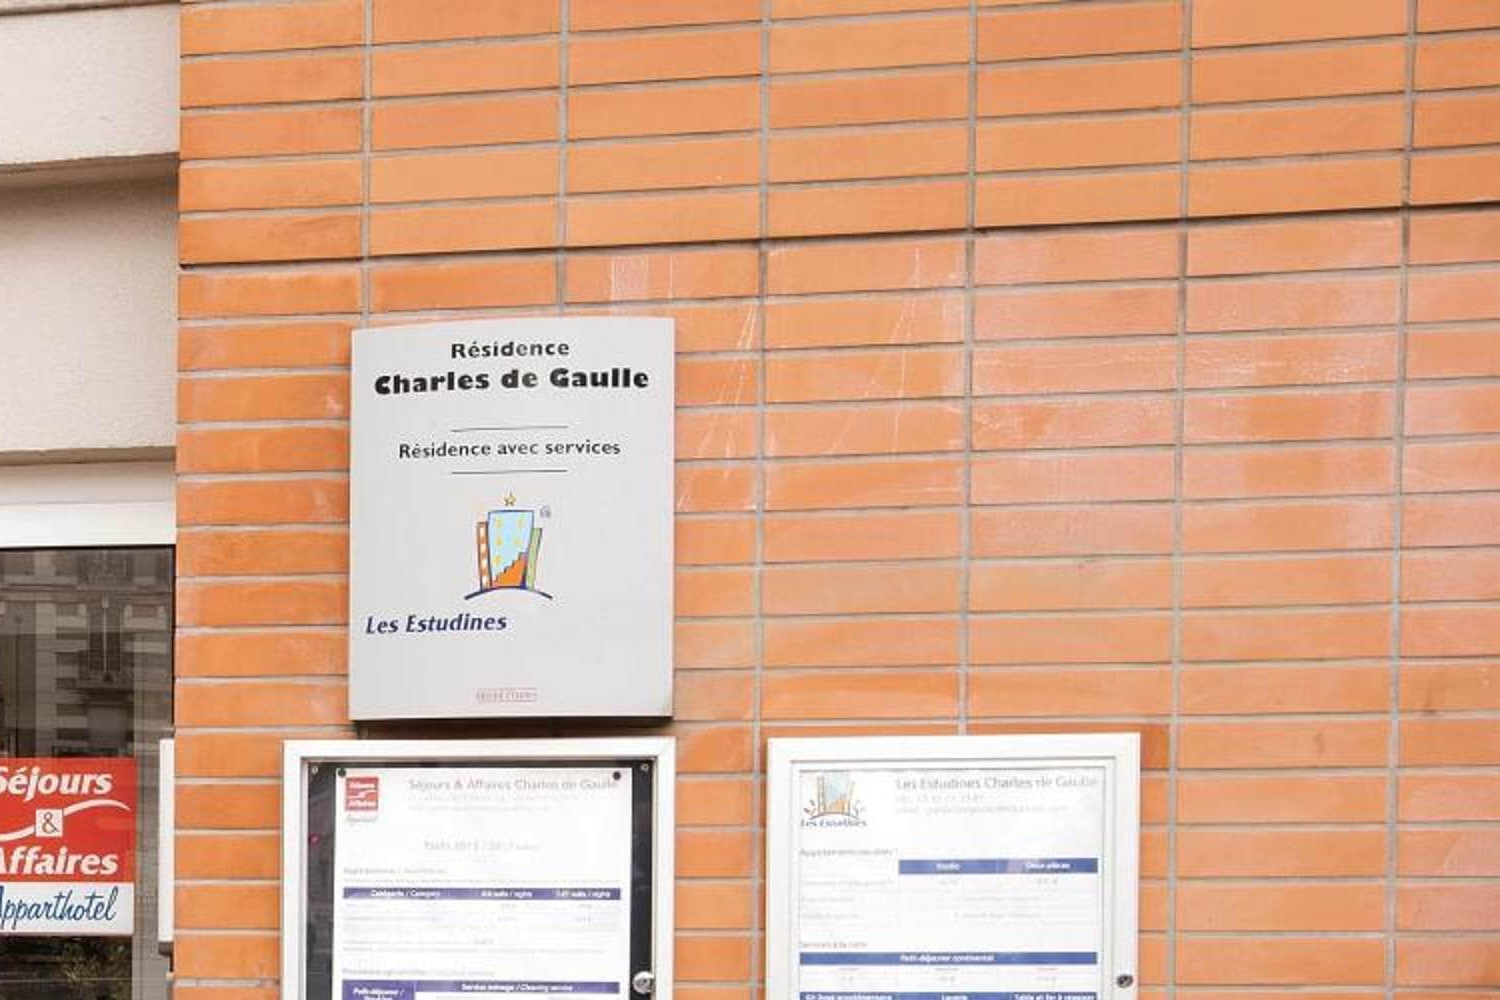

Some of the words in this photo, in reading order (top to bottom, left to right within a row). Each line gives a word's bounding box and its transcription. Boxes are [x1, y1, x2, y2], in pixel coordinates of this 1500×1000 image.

[451, 340, 570, 359] Résidence
[374, 370, 490, 396] Charles
[500, 368, 538, 389] de
[549, 367, 650, 389] Gaulle
[398, 440, 492, 460] Résidence
[496, 442, 539, 456] avec
[544, 439, 621, 456] services
[365, 615, 399, 634] Les
[405, 612, 508, 633] Estudines
[41, 811, 59, 834] &
